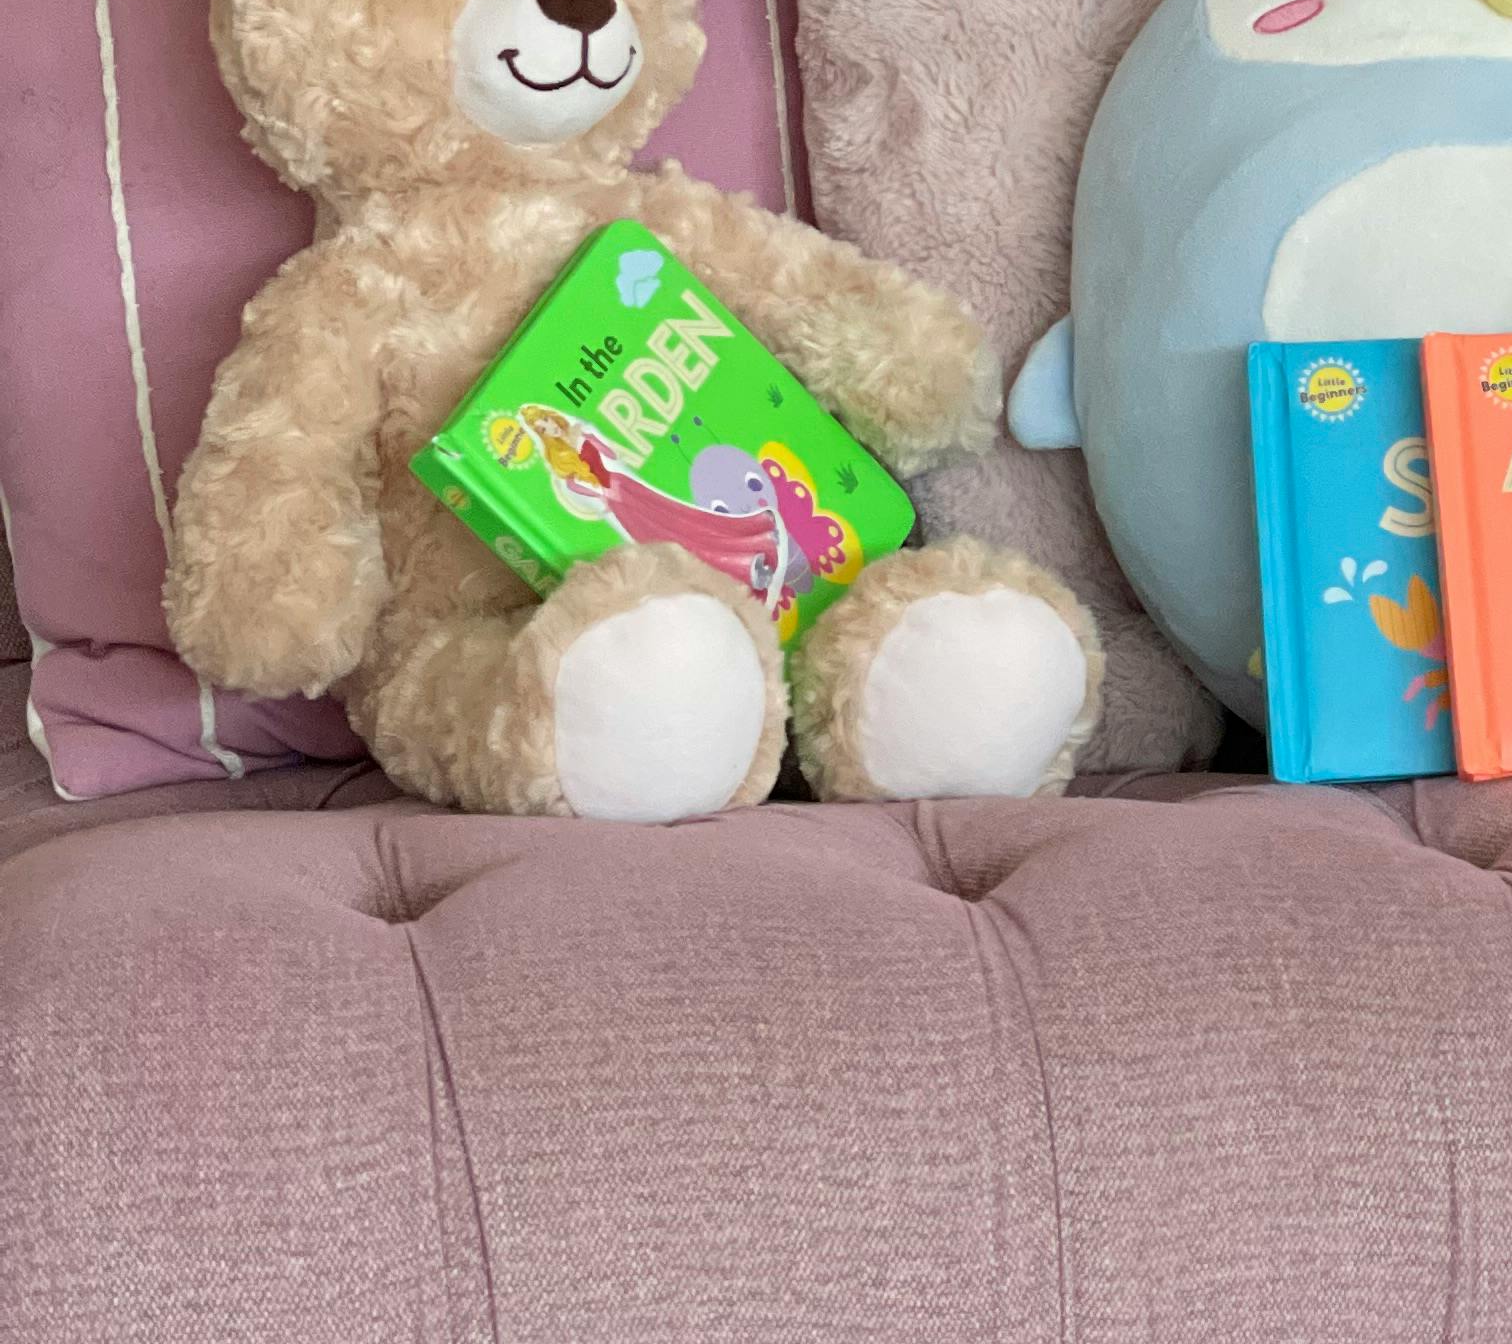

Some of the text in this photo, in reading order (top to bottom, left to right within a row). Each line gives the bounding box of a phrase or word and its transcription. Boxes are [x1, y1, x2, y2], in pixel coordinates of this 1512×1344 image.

[555, 336, 623, 408] In the
[1299, 385, 1367, 404] Beginners
[1318, 376, 1346, 387] Little
[1379, 437, 1436, 538] S
